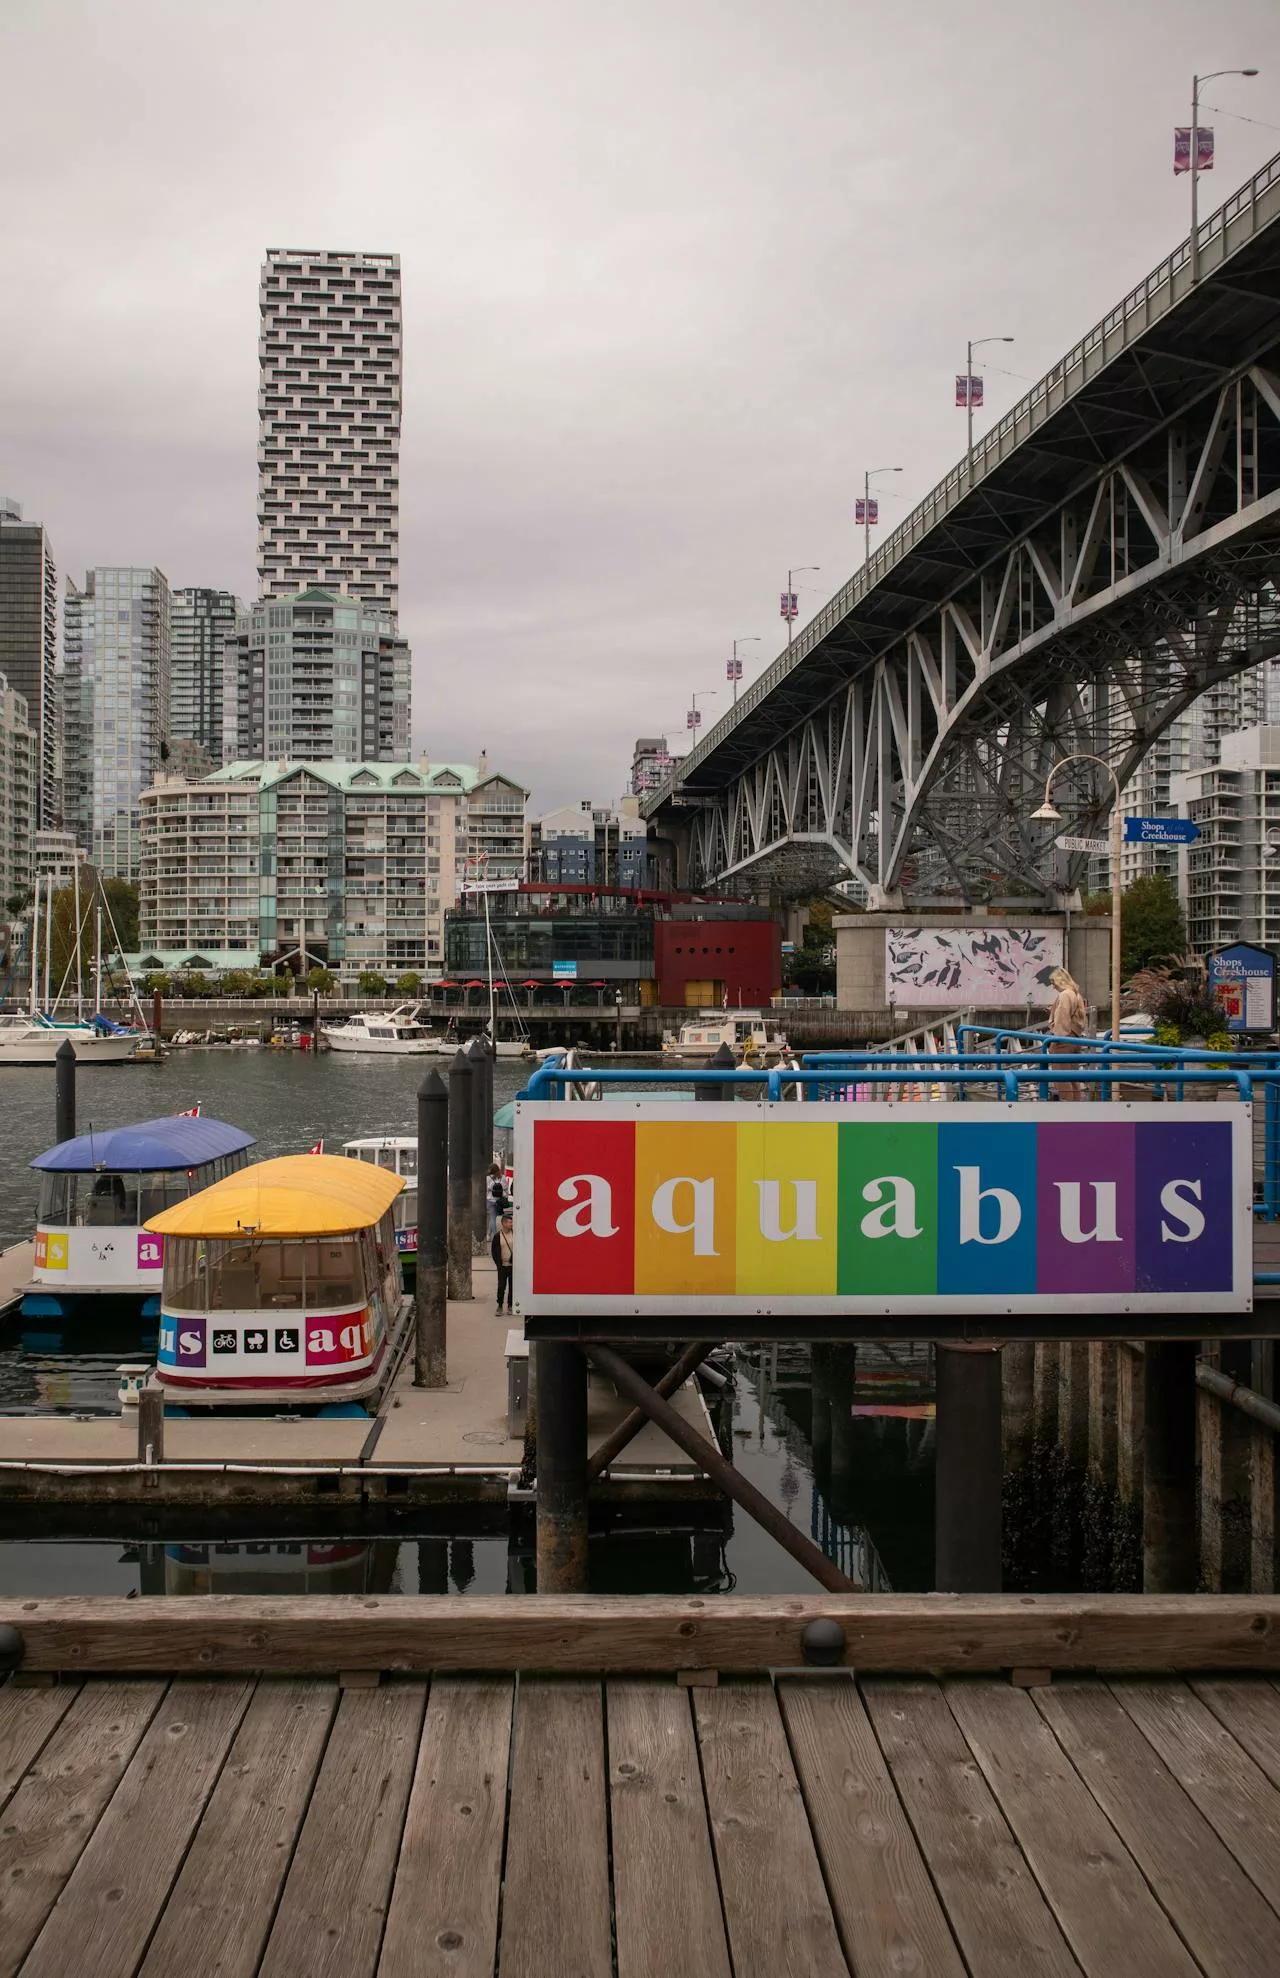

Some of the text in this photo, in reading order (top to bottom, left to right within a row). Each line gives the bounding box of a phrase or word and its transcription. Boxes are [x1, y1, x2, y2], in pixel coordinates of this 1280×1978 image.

[1141, 821, 1164, 832] Shops
[1141, 831, 1187, 841] Creekhouse
[1064, 838, 1106, 852] PUBLIC MARKET
[1213, 956, 1242, 968] Shops
[555, 1165, 1207, 1256] aquabus
